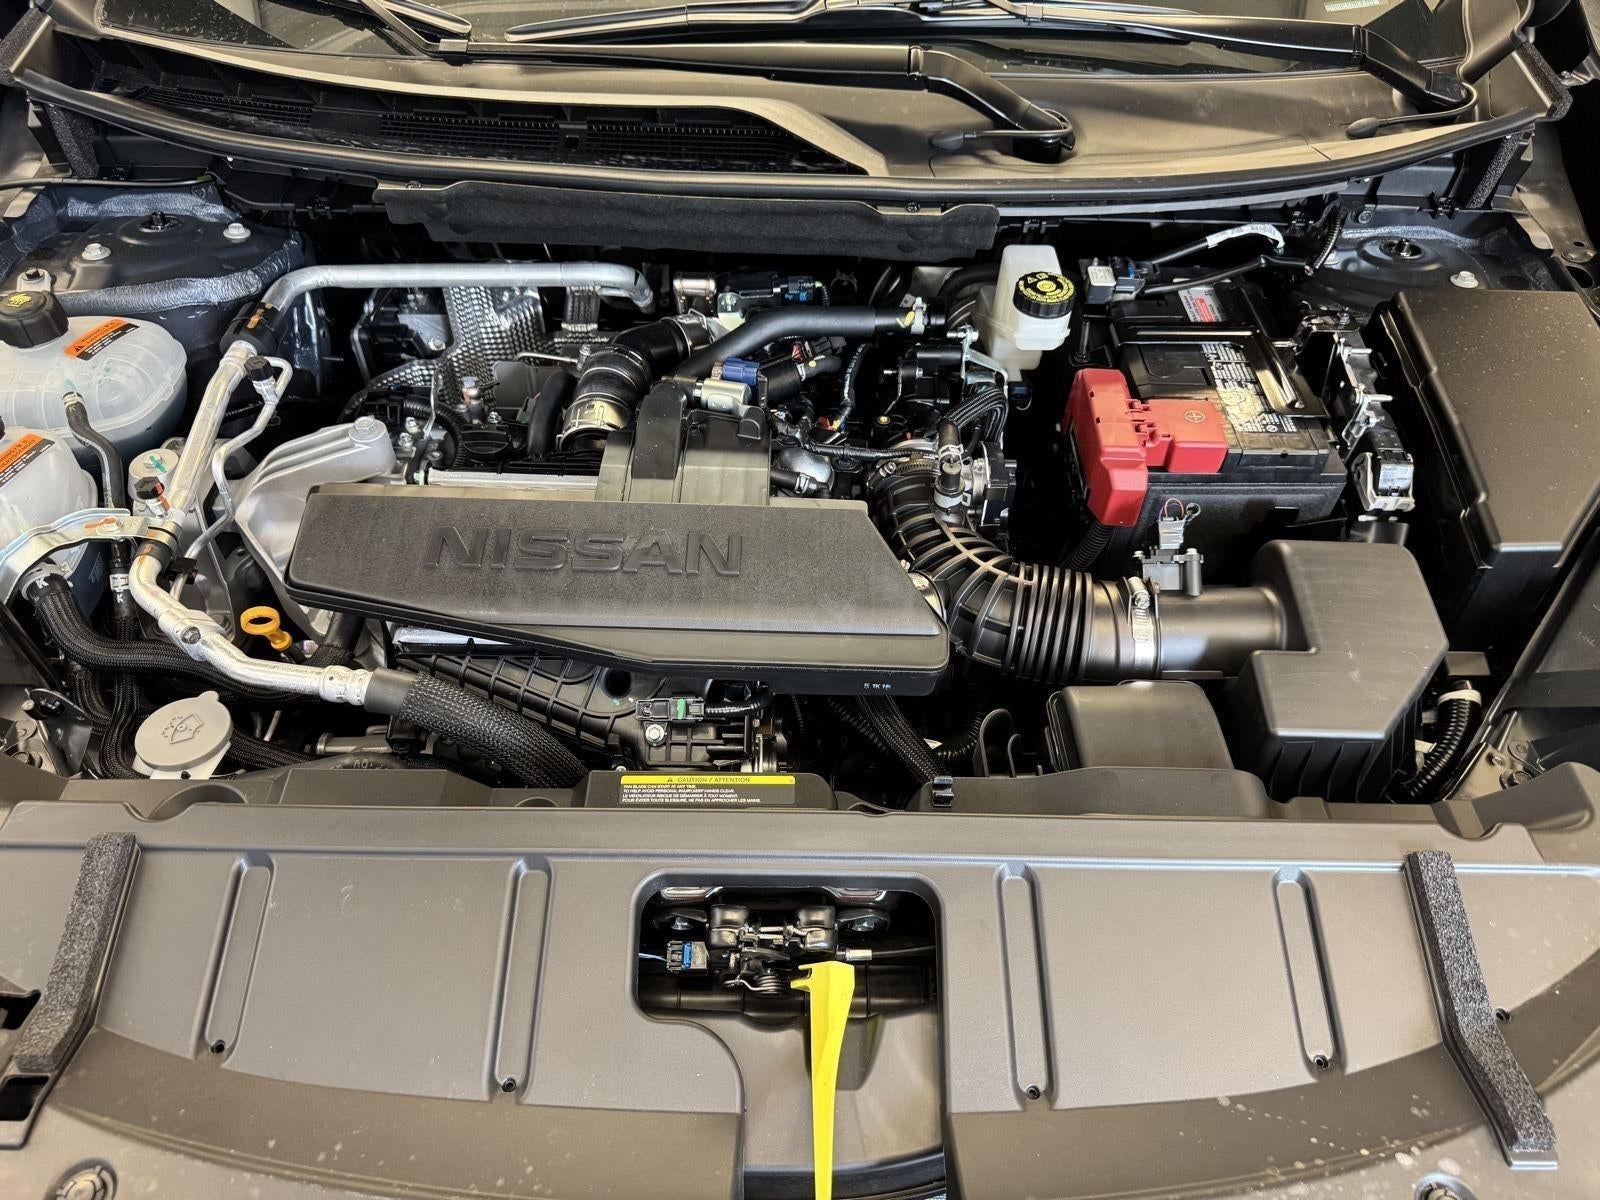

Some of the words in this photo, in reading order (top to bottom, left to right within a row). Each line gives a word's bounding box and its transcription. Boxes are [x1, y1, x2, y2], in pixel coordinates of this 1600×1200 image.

[423, 525, 743, 577] NISSAN
[36, 577, 49, 589] K
[116, 593, 124, 604] K
